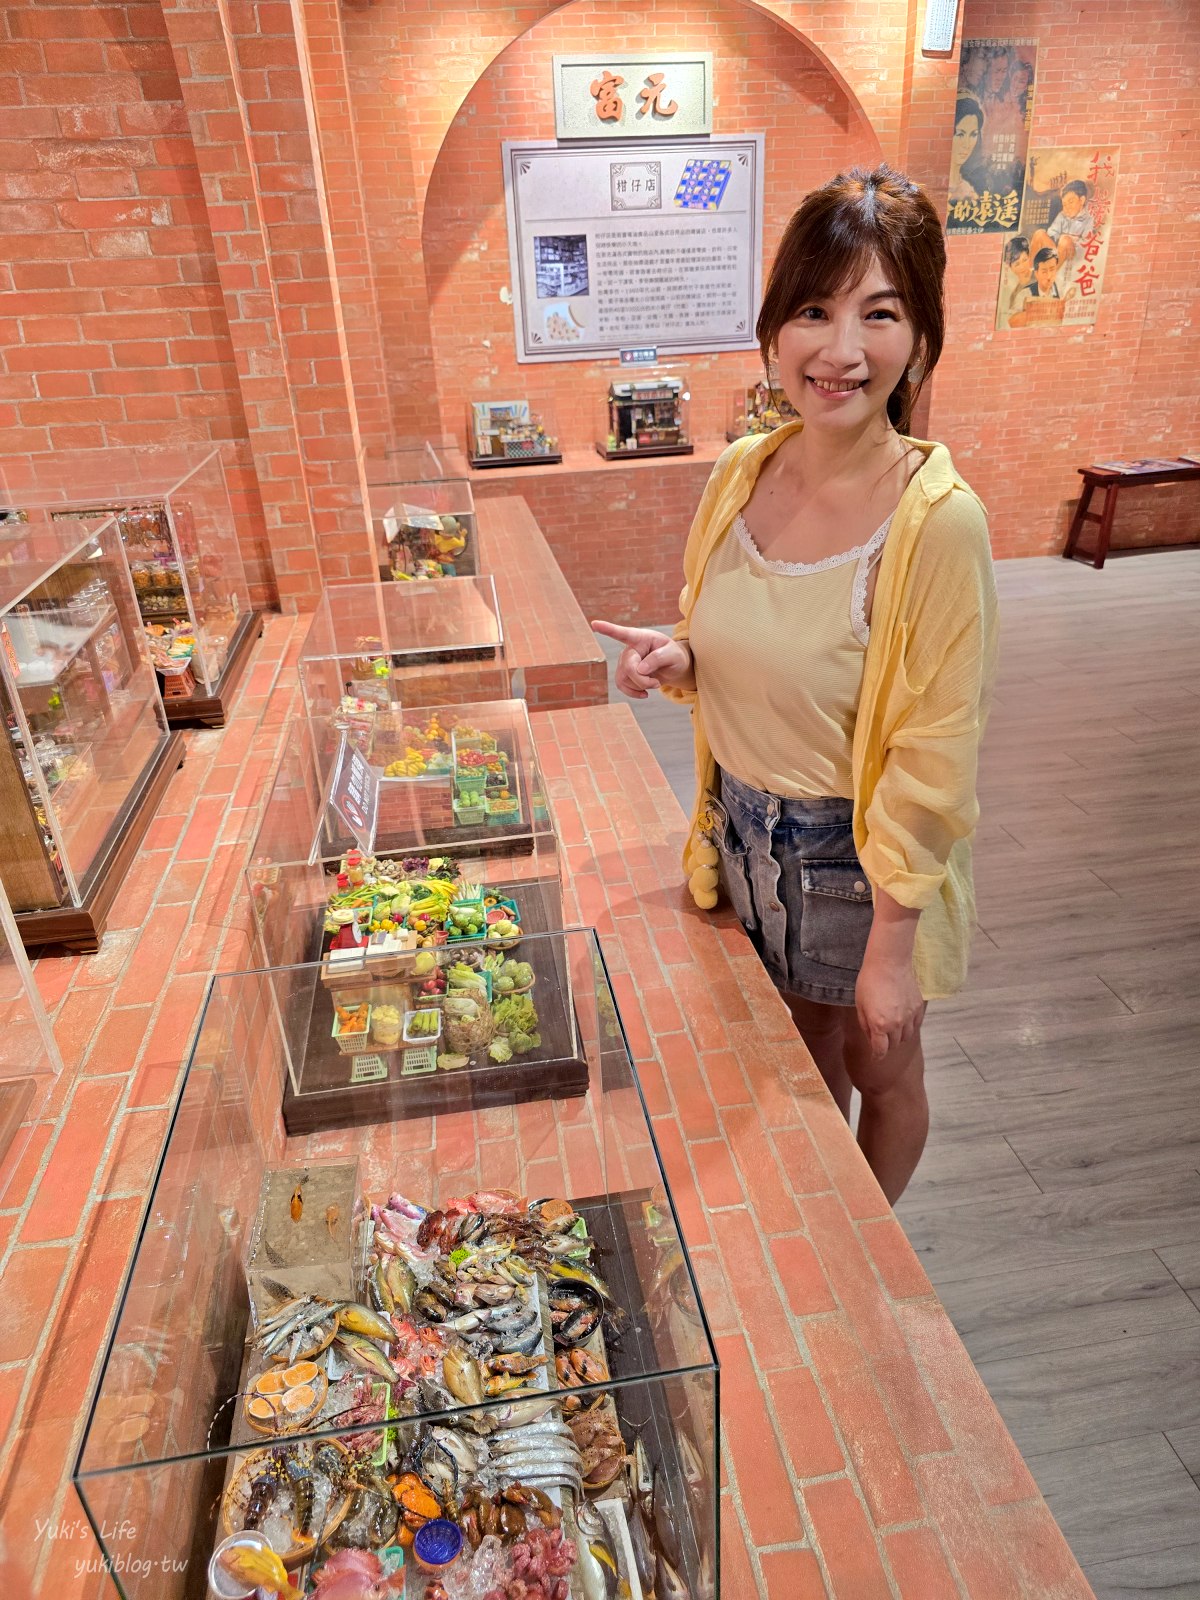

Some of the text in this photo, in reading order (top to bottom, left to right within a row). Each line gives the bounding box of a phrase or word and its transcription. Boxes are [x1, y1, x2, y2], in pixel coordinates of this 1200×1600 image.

[617, 179, 656, 193] 柑仔店
[1073, 151, 1115, 297] 我愛爸爸
